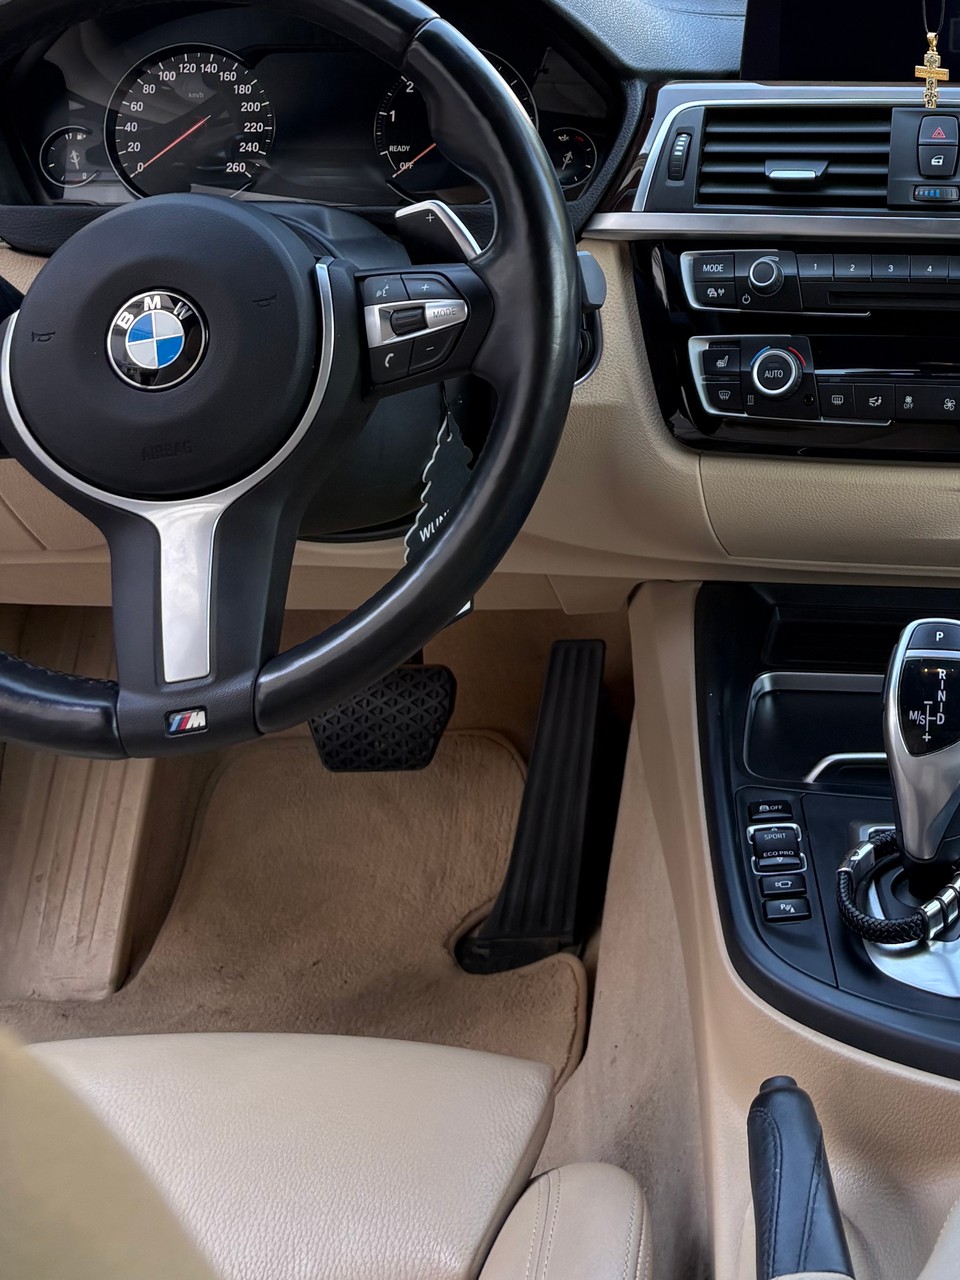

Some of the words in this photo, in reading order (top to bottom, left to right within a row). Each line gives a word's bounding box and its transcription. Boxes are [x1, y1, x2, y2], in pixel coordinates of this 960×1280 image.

[178, 63, 196, 73] 120
[200, 63, 218, 73] 140
[158, 71, 176, 81] 100
[219, 72, 237, 81] 160
[142, 84, 156, 94] 80
[233, 84, 252, 94] 180
[405, 81, 414, 93] 2
[130, 101, 144, 111] 60
[240, 102, 261, 112] 200
[389, 110, 396, 122] 1
[124, 122, 138, 132] 40
[243, 122, 264, 132] 220
[127, 142, 141, 151] 20
[239, 142, 259, 152] 240
[137, 163, 144, 172] 0
[226, 162, 246, 172] 260
[702, 263, 724, 272] MODE
[850, 264, 856, 272] 2
[926, 265, 933, 273] 4
[117, 295, 192, 330] BMW
[433, 307, 457, 319] MODE
[764, 370, 784, 378] AUTO
[936, 631, 944, 641] P
[938, 669, 946, 680] R
[937, 690, 946, 701] N
[936, 713, 945, 725] D
